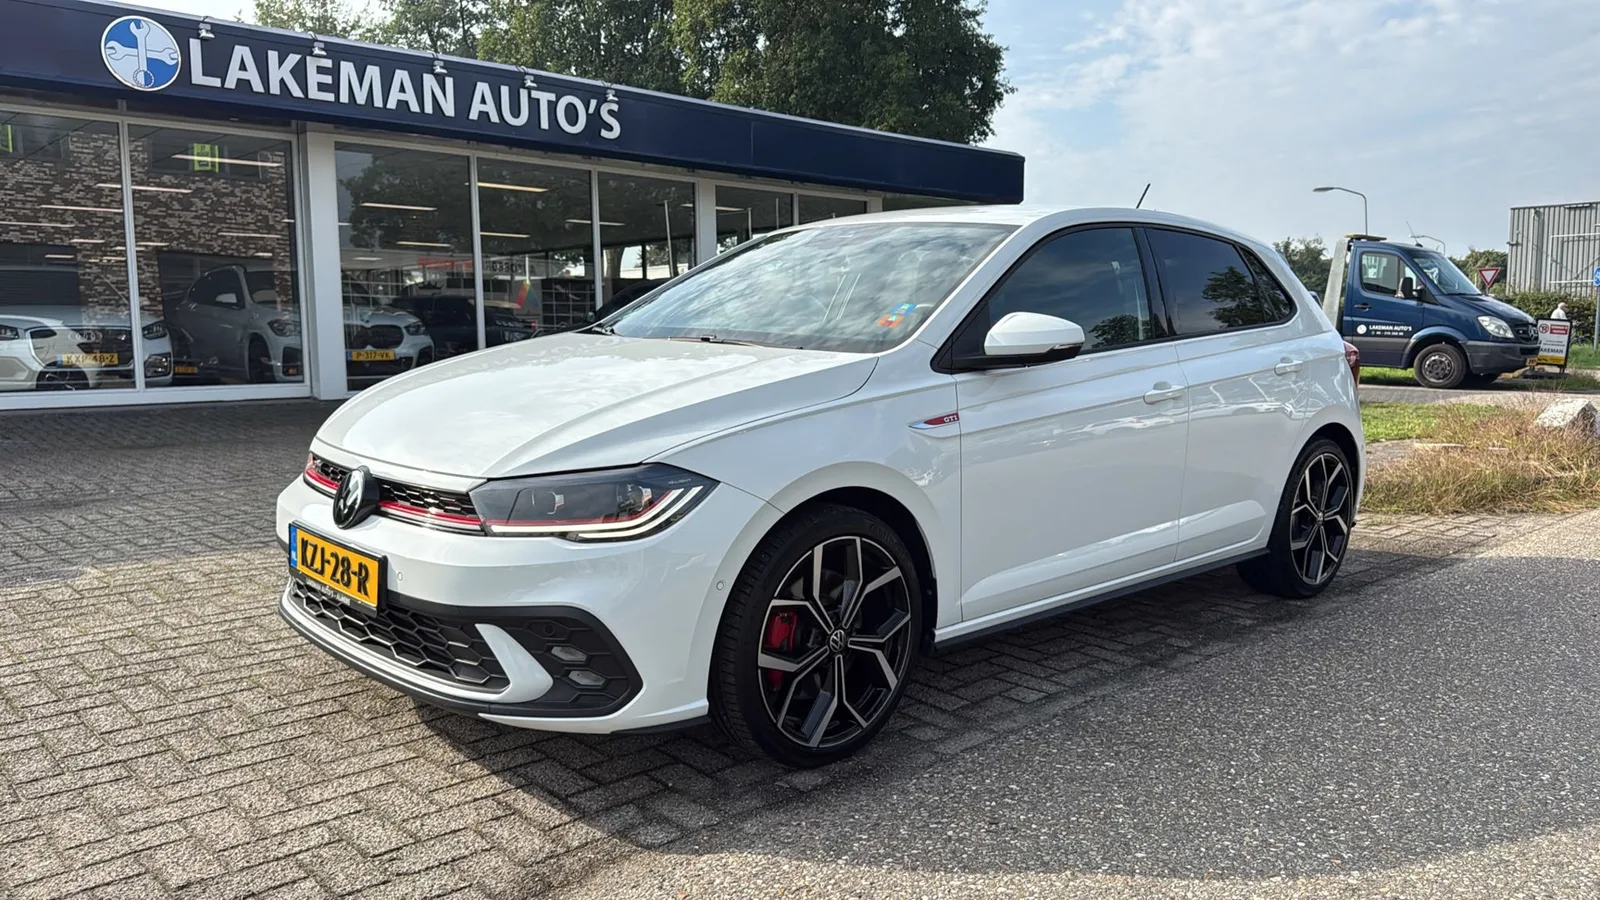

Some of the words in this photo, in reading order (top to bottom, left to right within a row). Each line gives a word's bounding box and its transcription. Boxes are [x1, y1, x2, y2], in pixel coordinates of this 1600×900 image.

[189, 38, 456, 118] LAKEMAN
[468, 81, 622, 140] AUTO'S
[1540, 346, 1564, 354] AKEMAN
[943, 415, 958, 423] GTI
[301, 537, 370, 599] KZJ-28-R
